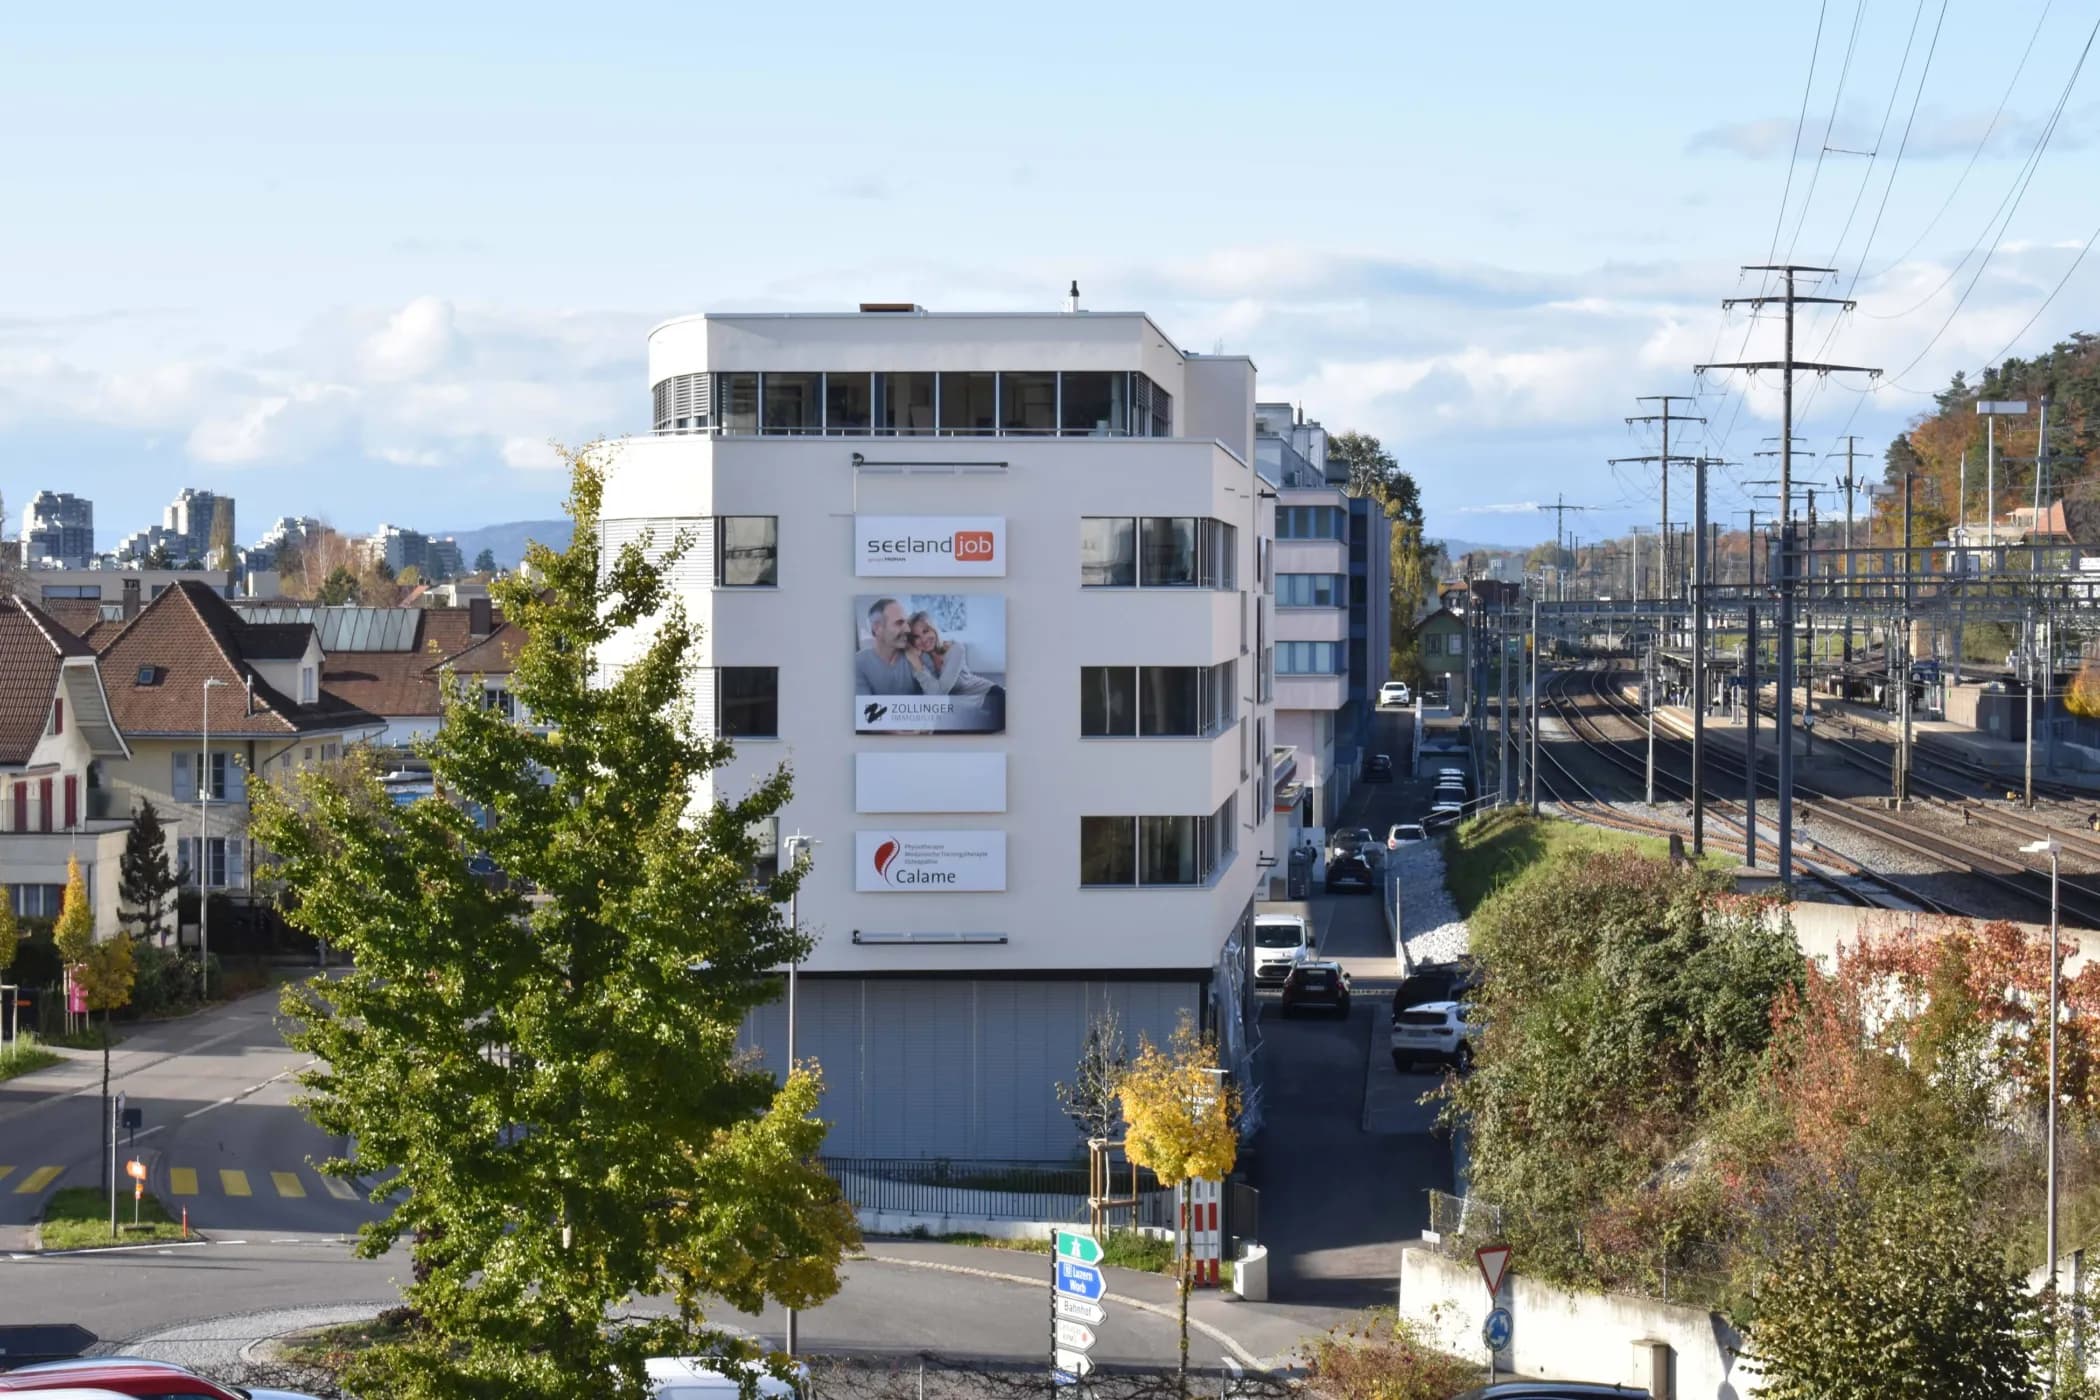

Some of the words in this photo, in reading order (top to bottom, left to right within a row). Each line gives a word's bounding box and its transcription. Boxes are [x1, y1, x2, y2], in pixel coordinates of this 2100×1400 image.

[868, 536, 952, 553] seeland
[956, 535, 992, 557] job
[891, 704, 954, 713] ZOLLINGER
[896, 868, 956, 883] Calame
[1073, 1267, 1093, 1281] Luzern
[1069, 1279, 1087, 1294] Worb
[1064, 1300, 1091, 1316] Bahnhof
